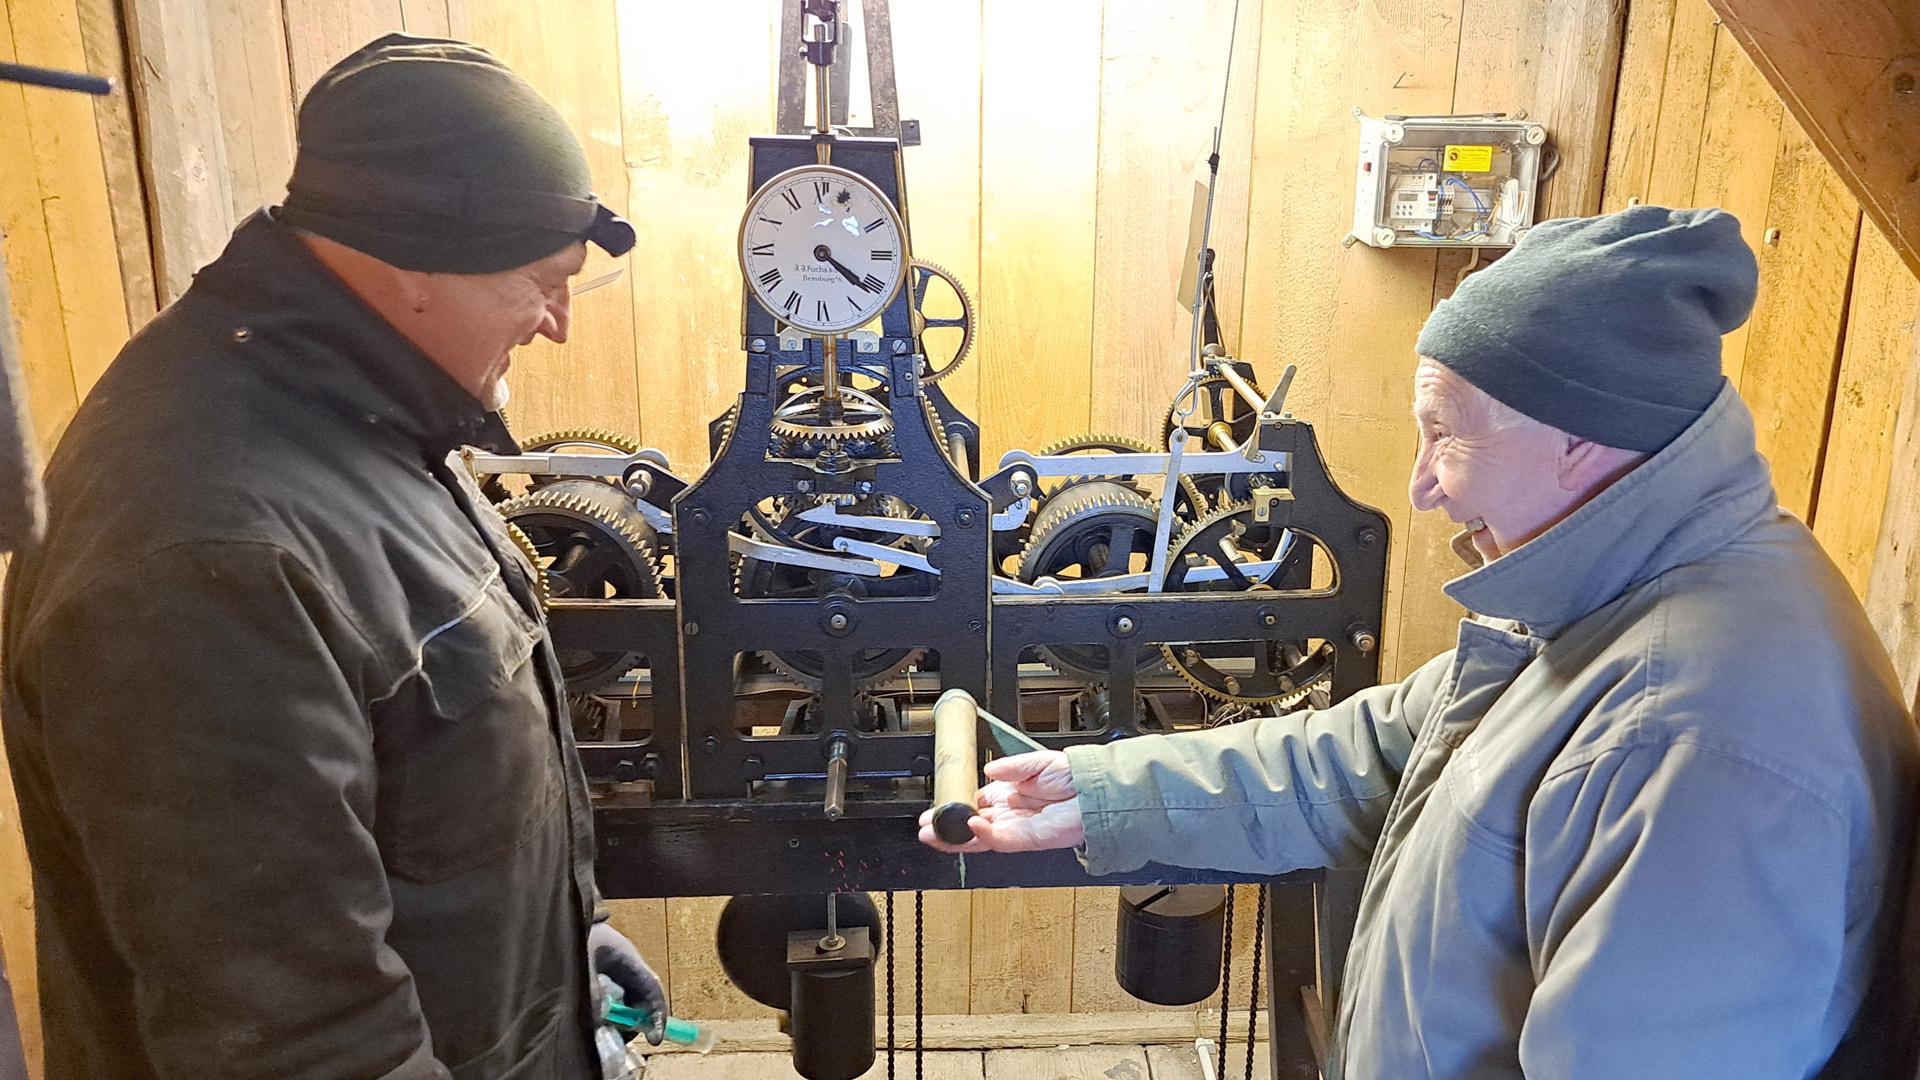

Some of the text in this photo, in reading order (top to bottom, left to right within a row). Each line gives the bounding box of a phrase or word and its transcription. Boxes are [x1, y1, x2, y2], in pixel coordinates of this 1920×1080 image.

[781, 188, 802, 214] XI
[759, 211, 783, 231] X
[864, 218, 885, 233] II
[871, 250, 893, 261] III
[759, 268, 783, 293] VIII
[783, 290, 802, 315] VII
[817, 300, 830, 322] VI
